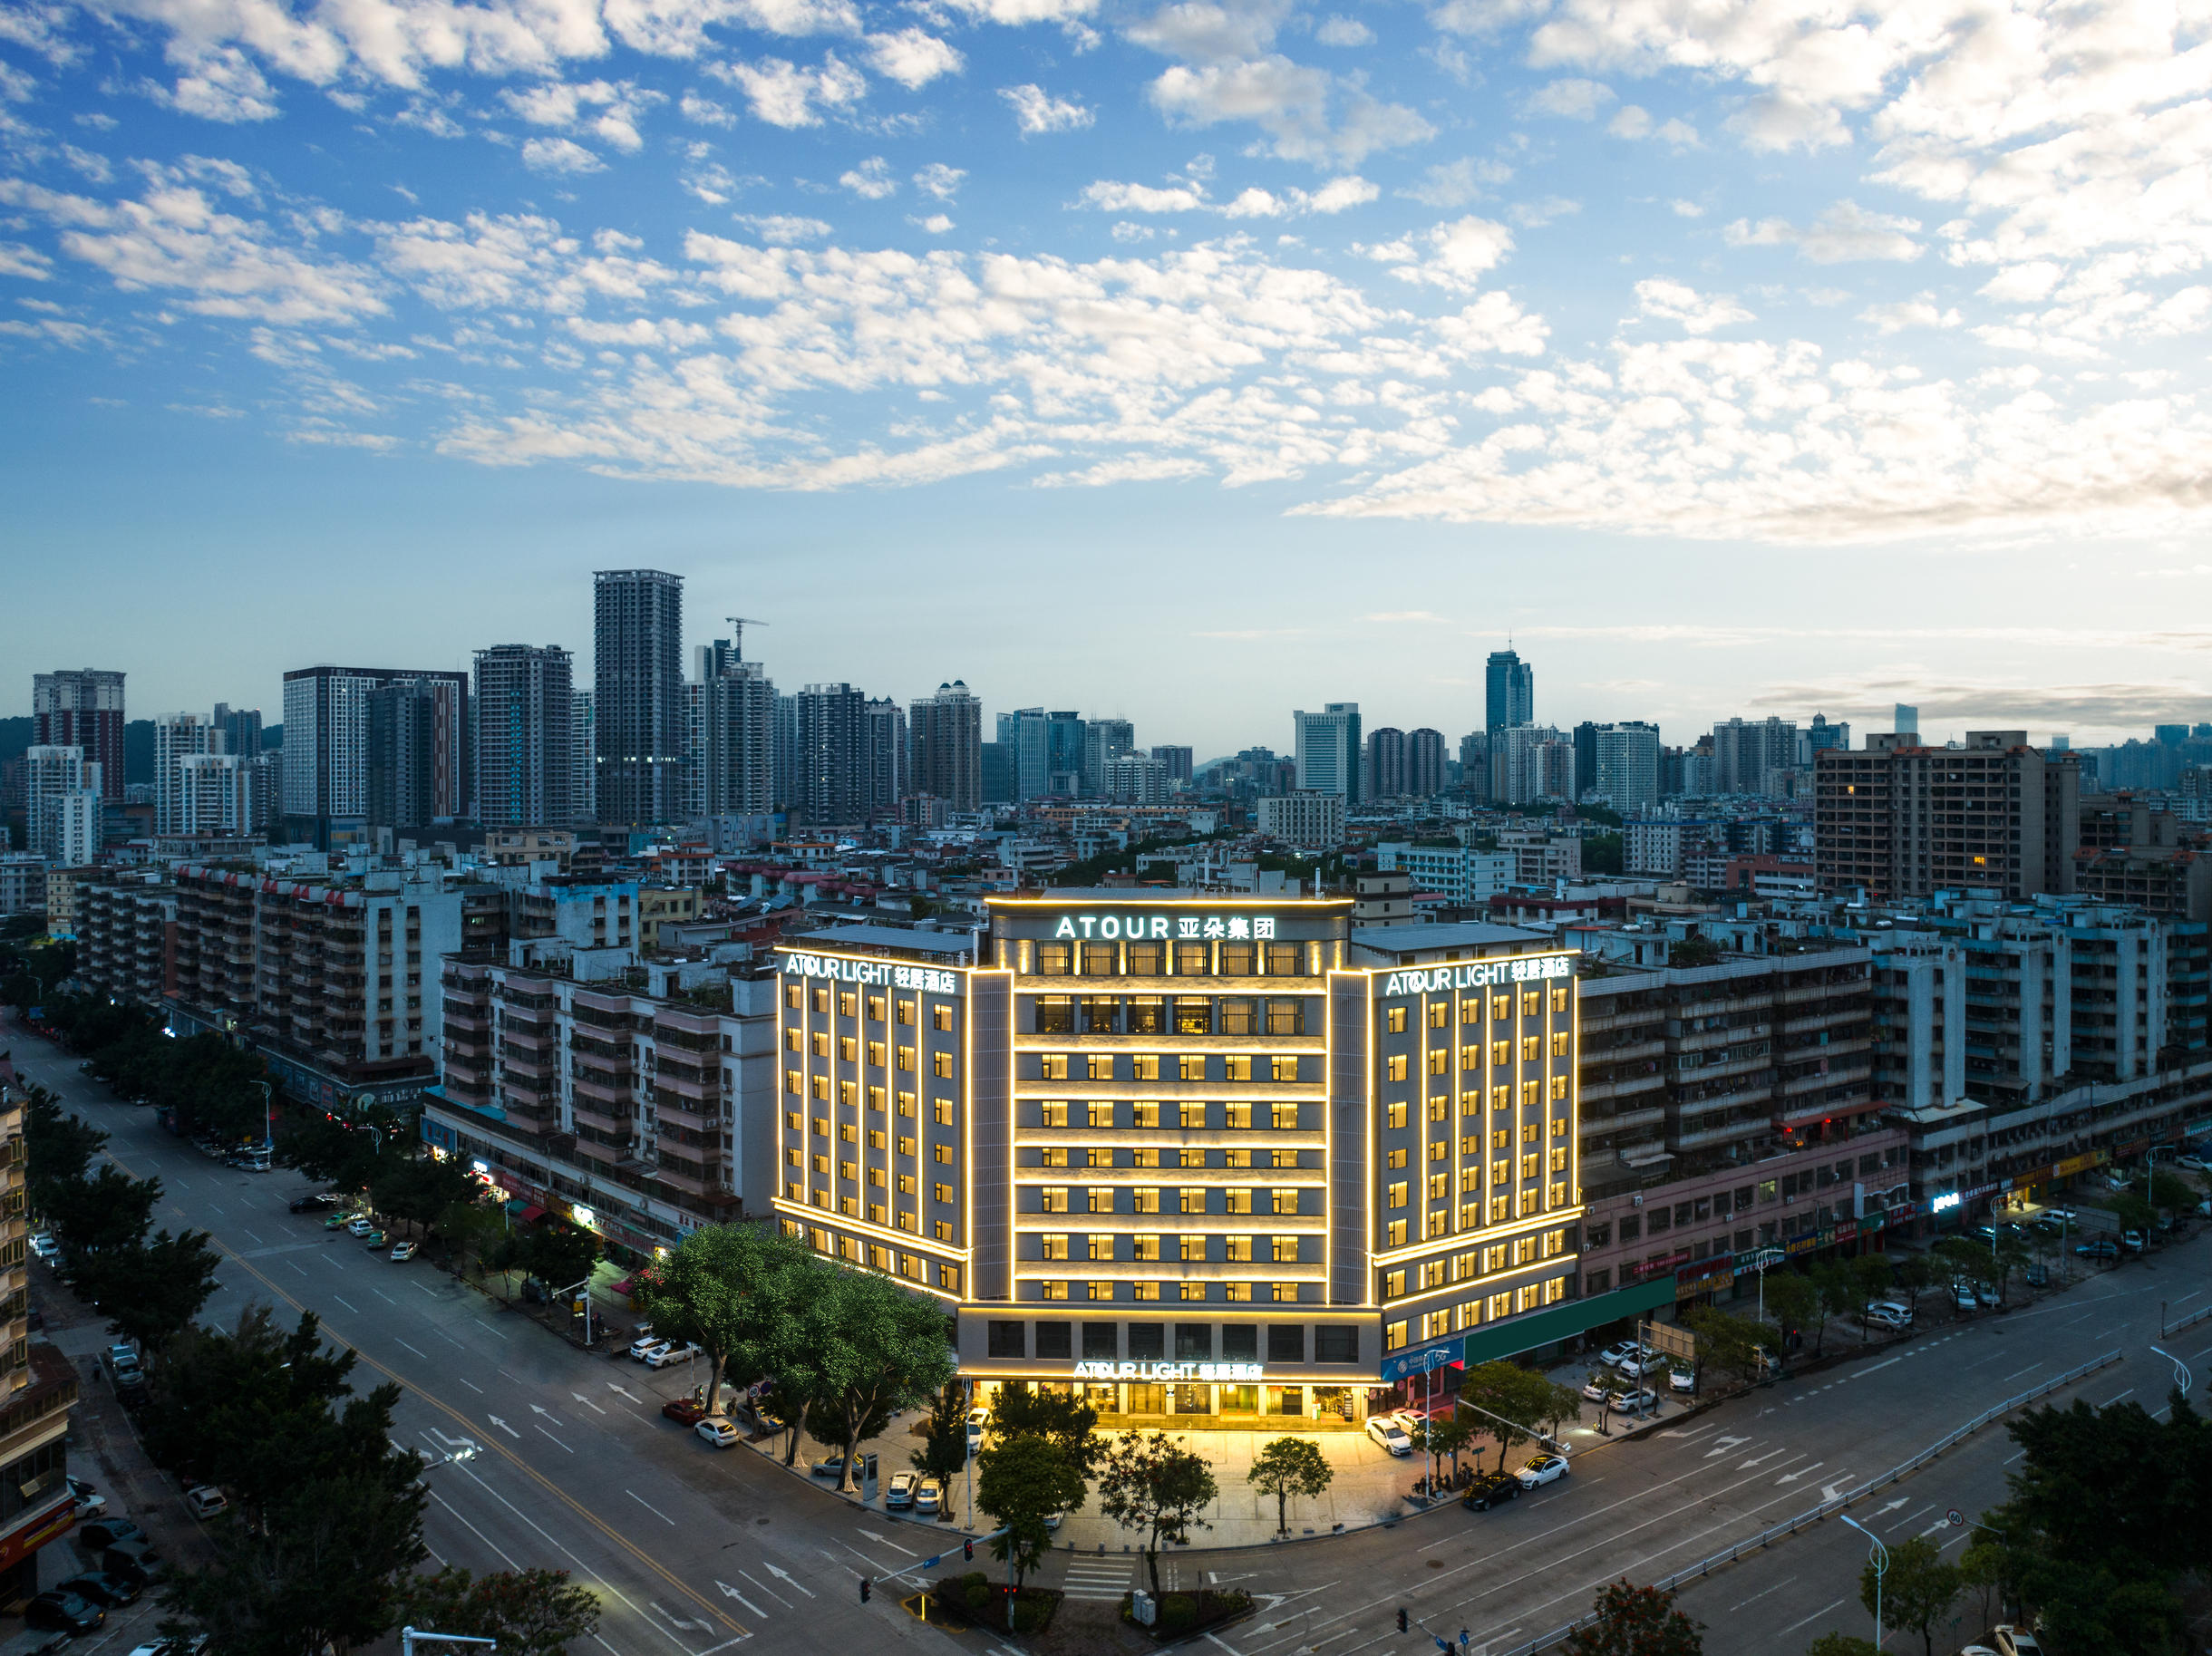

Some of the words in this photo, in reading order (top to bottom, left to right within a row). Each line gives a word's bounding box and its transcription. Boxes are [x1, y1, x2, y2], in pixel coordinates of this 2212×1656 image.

[1055, 916, 1169, 939] ATOUR
[1179, 916, 1276, 940] 亚朵集团
[786, 954, 839, 980] ATOUR
[842, 960, 892, 986] LIGHT
[894, 965, 956, 994] 轻居酒店
[1386, 968, 1451, 996] ATOUR
[1455, 962, 1509, 988] LIGHT
[1510, 956, 1569, 982] 轻居酒店
[1073, 1361, 1137, 1380] ATOUR
[1140, 1362, 1197, 1380] LIGHT
[1951, 1513, 1961, 1524] 60
